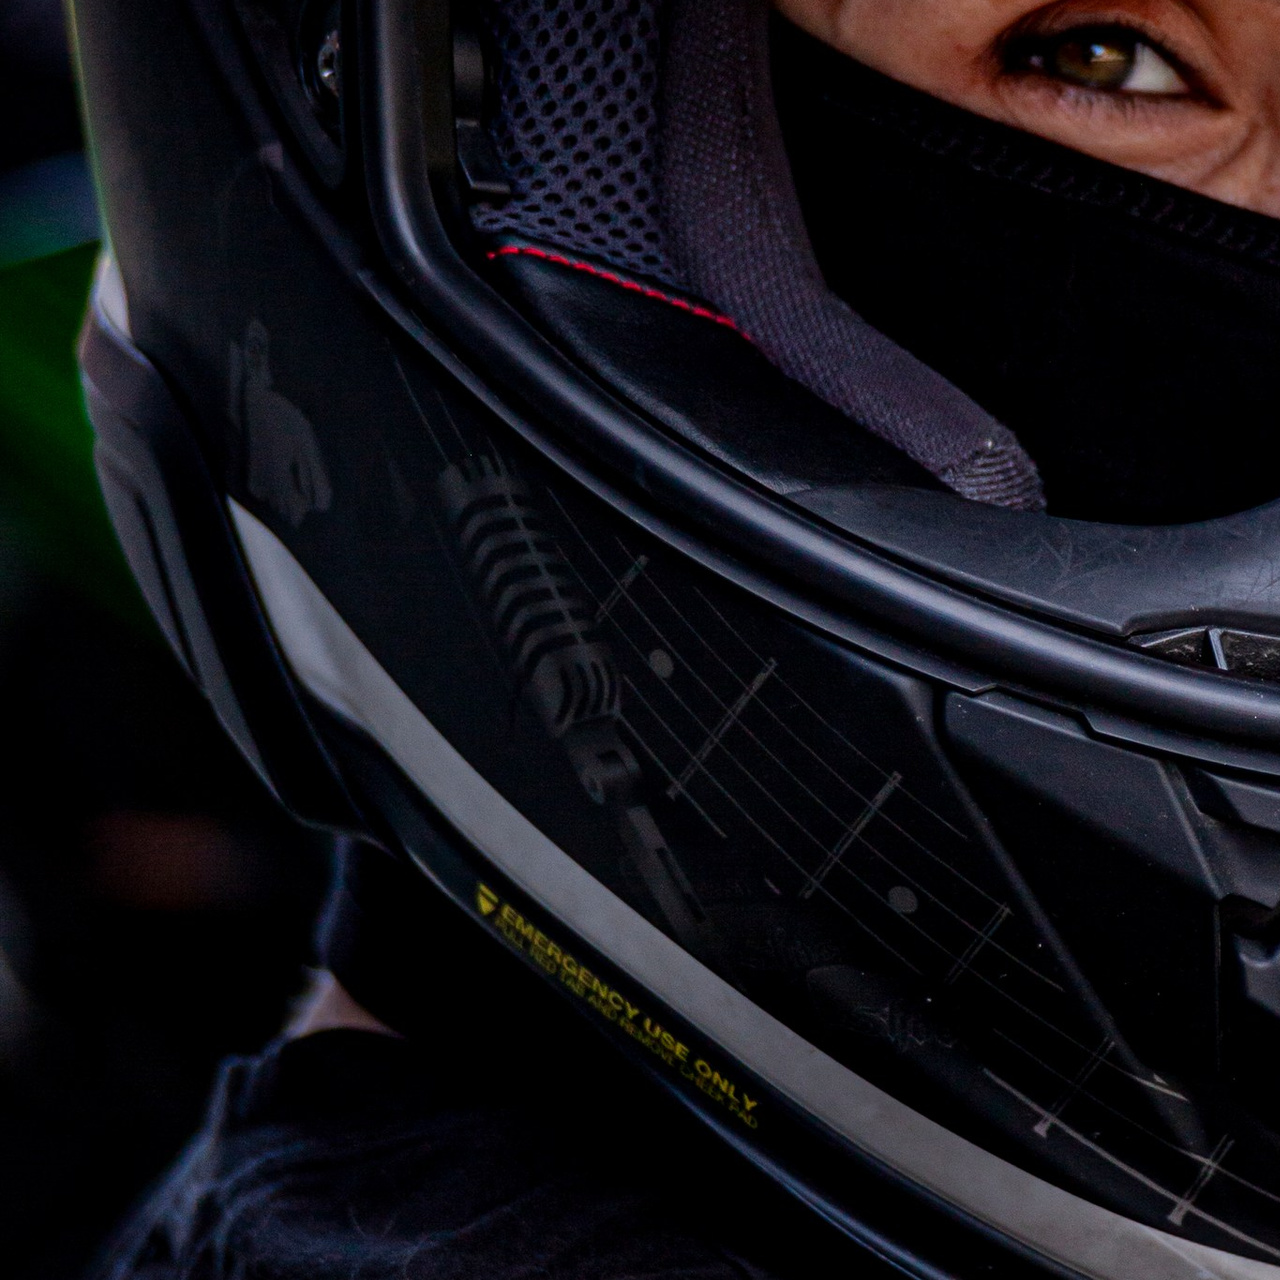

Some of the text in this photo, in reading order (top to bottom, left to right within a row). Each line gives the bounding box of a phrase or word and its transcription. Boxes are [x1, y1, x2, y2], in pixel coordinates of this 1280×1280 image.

[500, 903, 758, 1113] EMERGENCY USE ONLY
